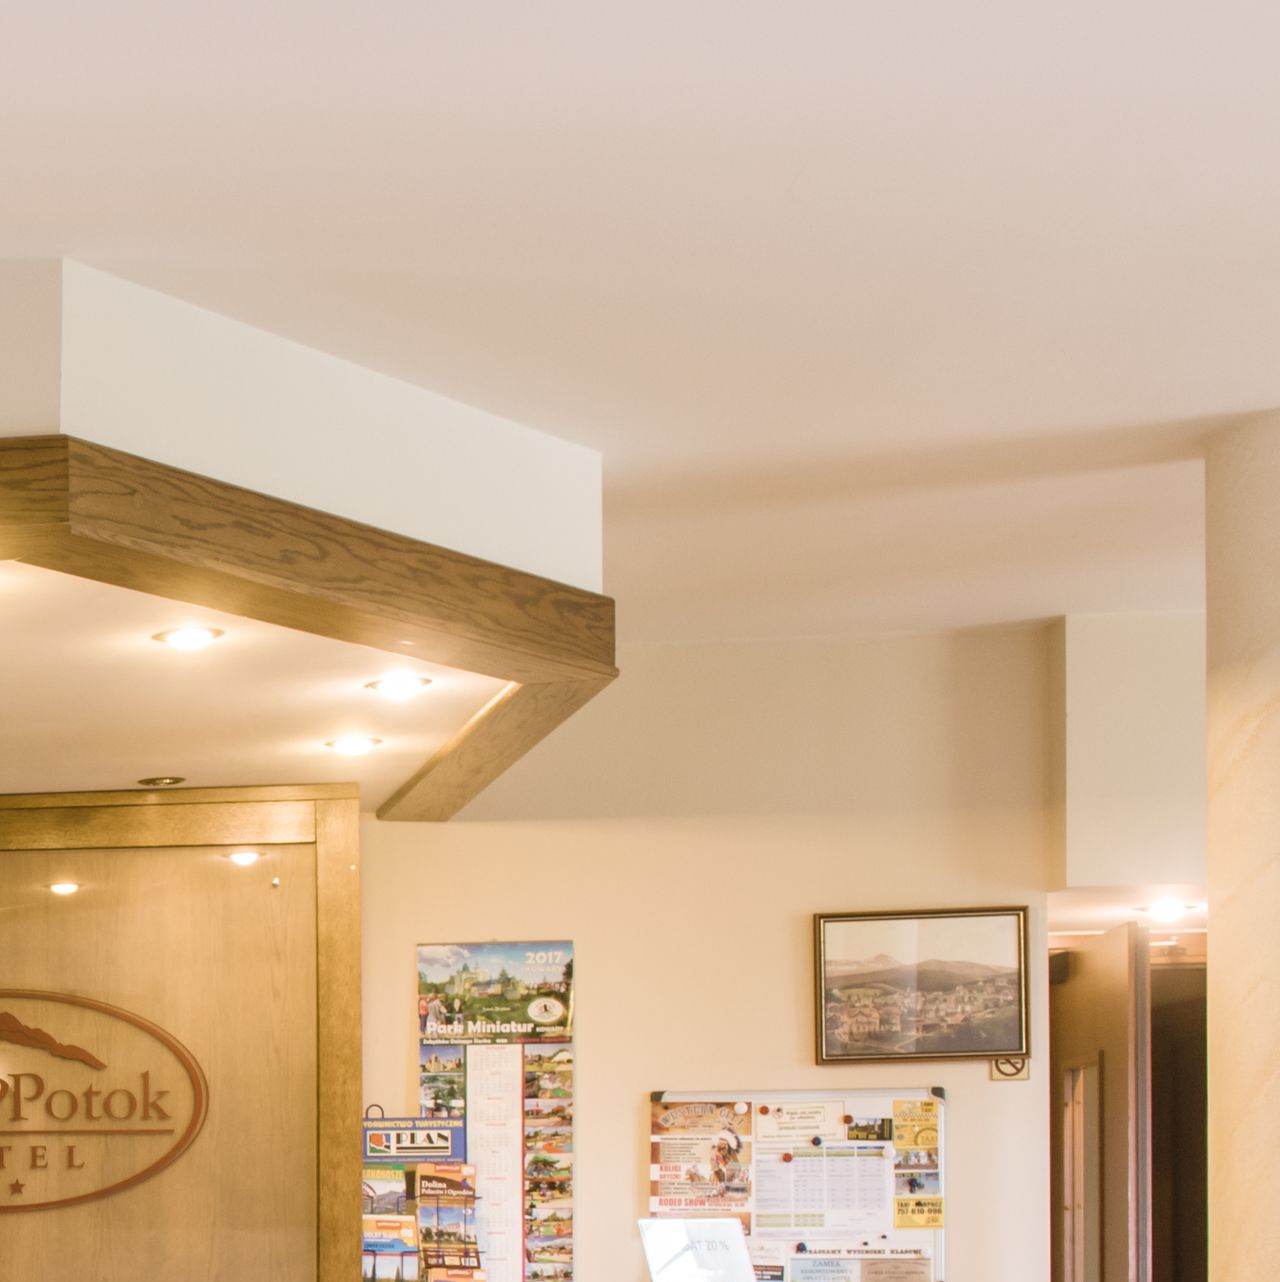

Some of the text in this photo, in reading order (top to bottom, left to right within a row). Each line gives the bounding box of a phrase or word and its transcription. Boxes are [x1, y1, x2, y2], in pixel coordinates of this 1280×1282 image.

[525, 951, 563, 965] 2017
[426, 1020, 465, 1034] Park
[467, 1019, 535, 1034] Miniatur
[6, 1070, 174, 1124] Potok
[659, 1103, 717, 1128] WESTERN
[396, 1132, 449, 1144] PLAN
[421, 1180, 447, 1189] Dolina
[658, 1197, 707, 1207] RODEO SHOW
[705, 1240, 718, 1250] 20
[719, 1240, 729, 1250] %
